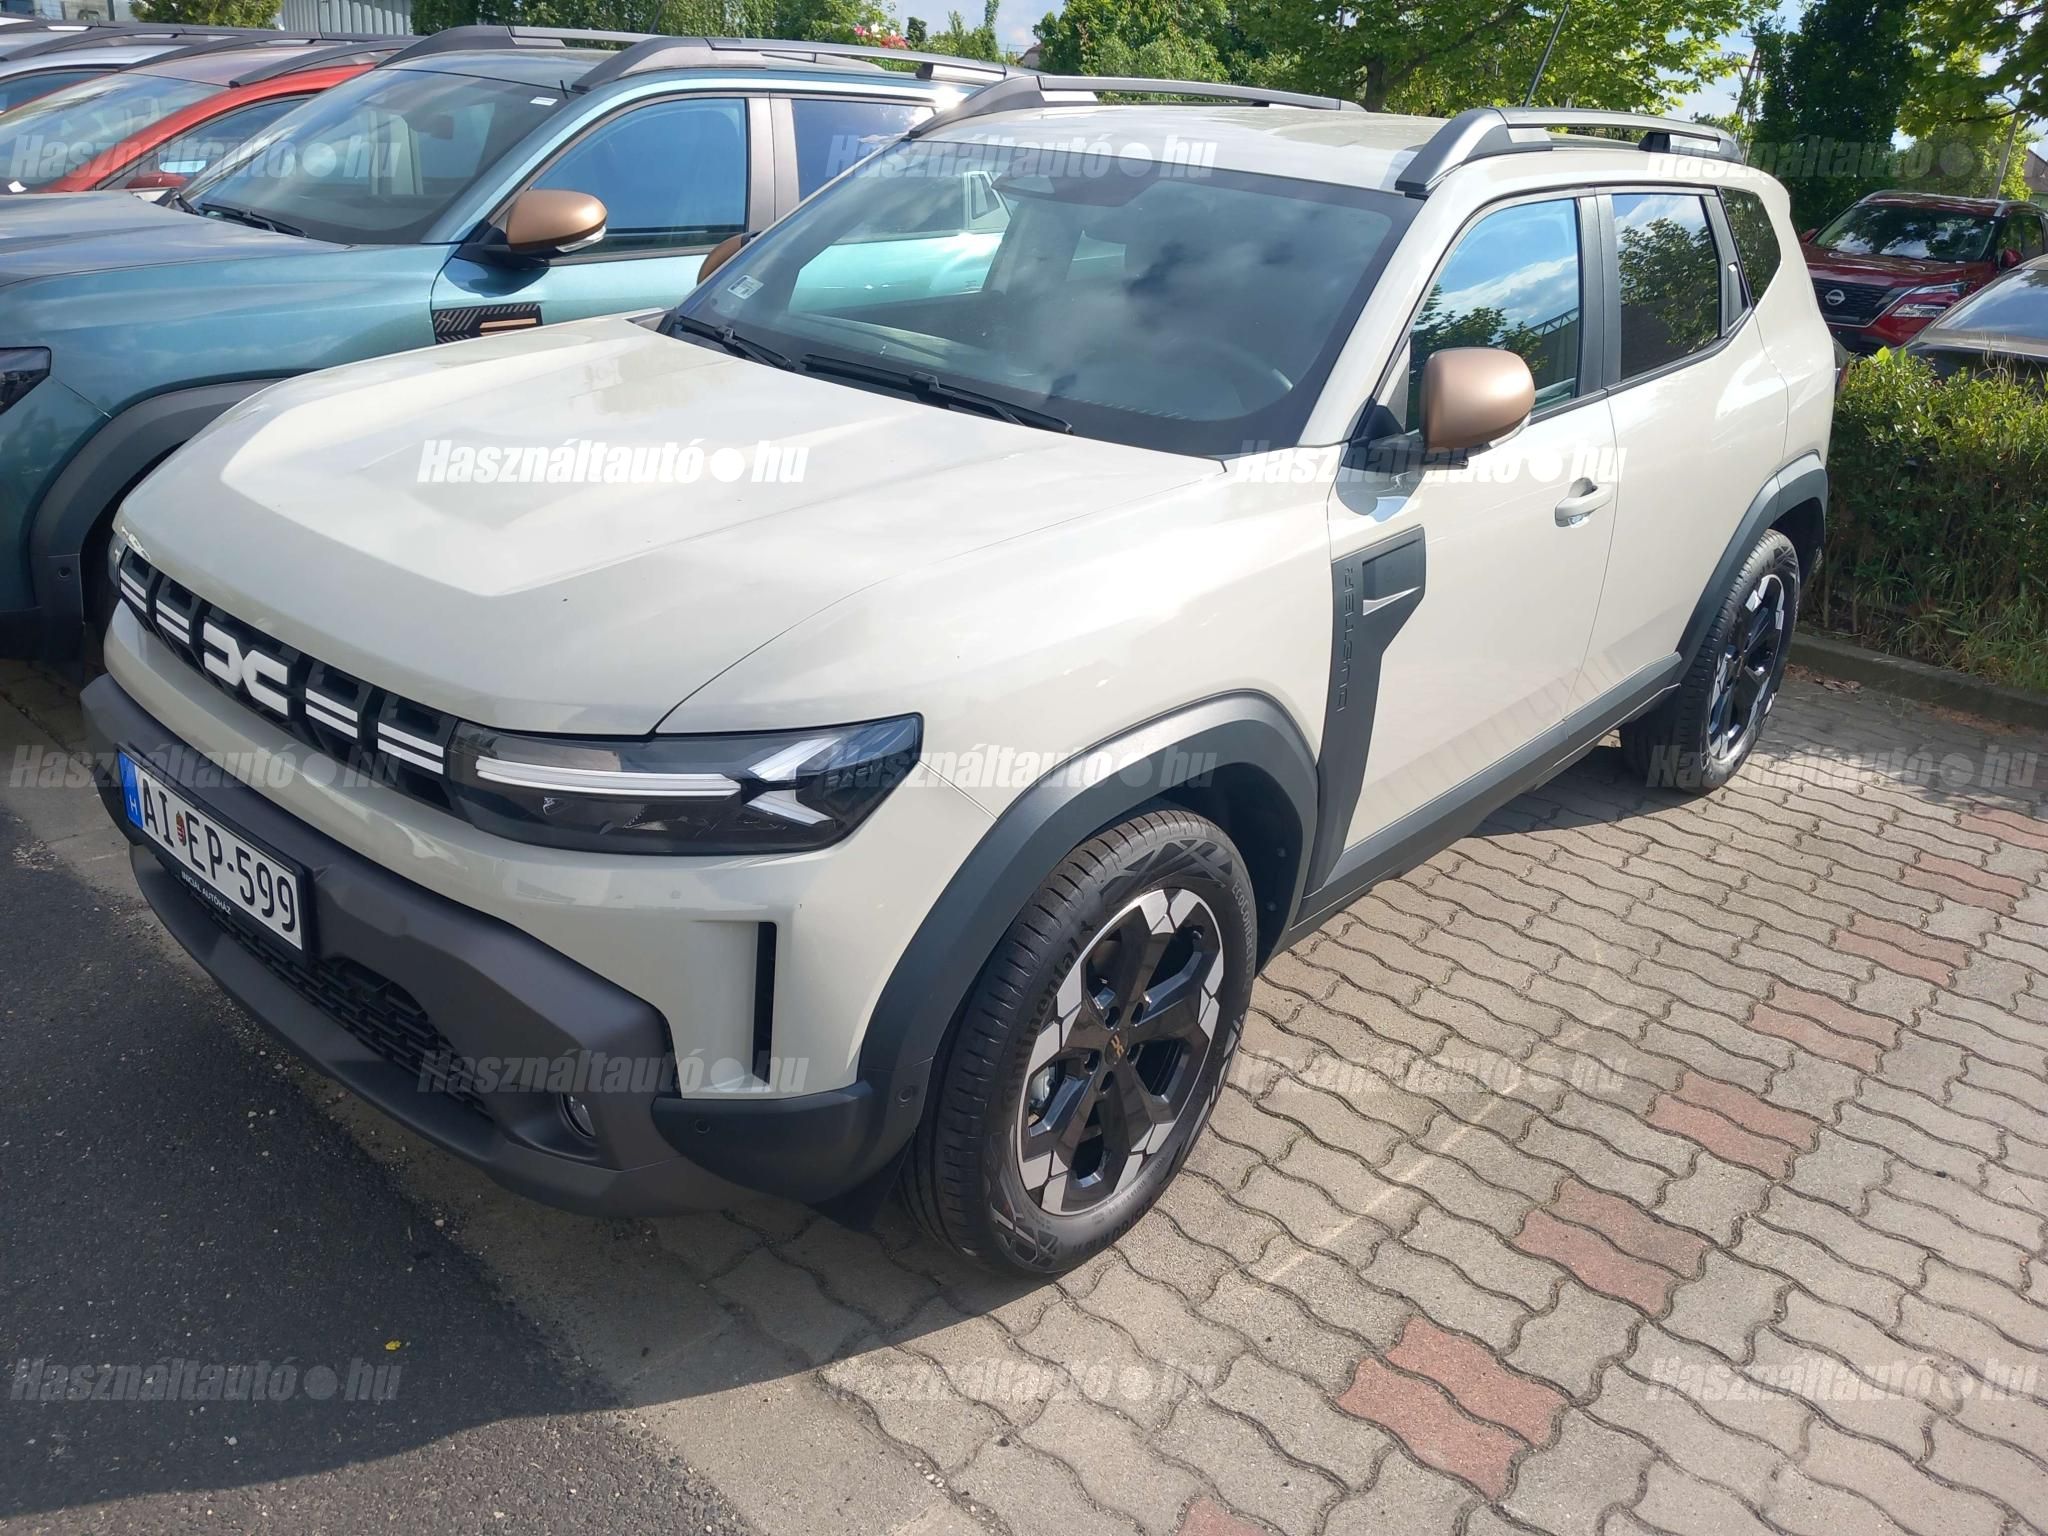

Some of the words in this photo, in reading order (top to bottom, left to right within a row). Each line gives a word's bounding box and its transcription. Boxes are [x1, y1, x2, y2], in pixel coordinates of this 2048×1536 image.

[128, 794, 138, 815] H
[142, 778, 174, 848] AI
[185, 810, 296, 933] EP-599
